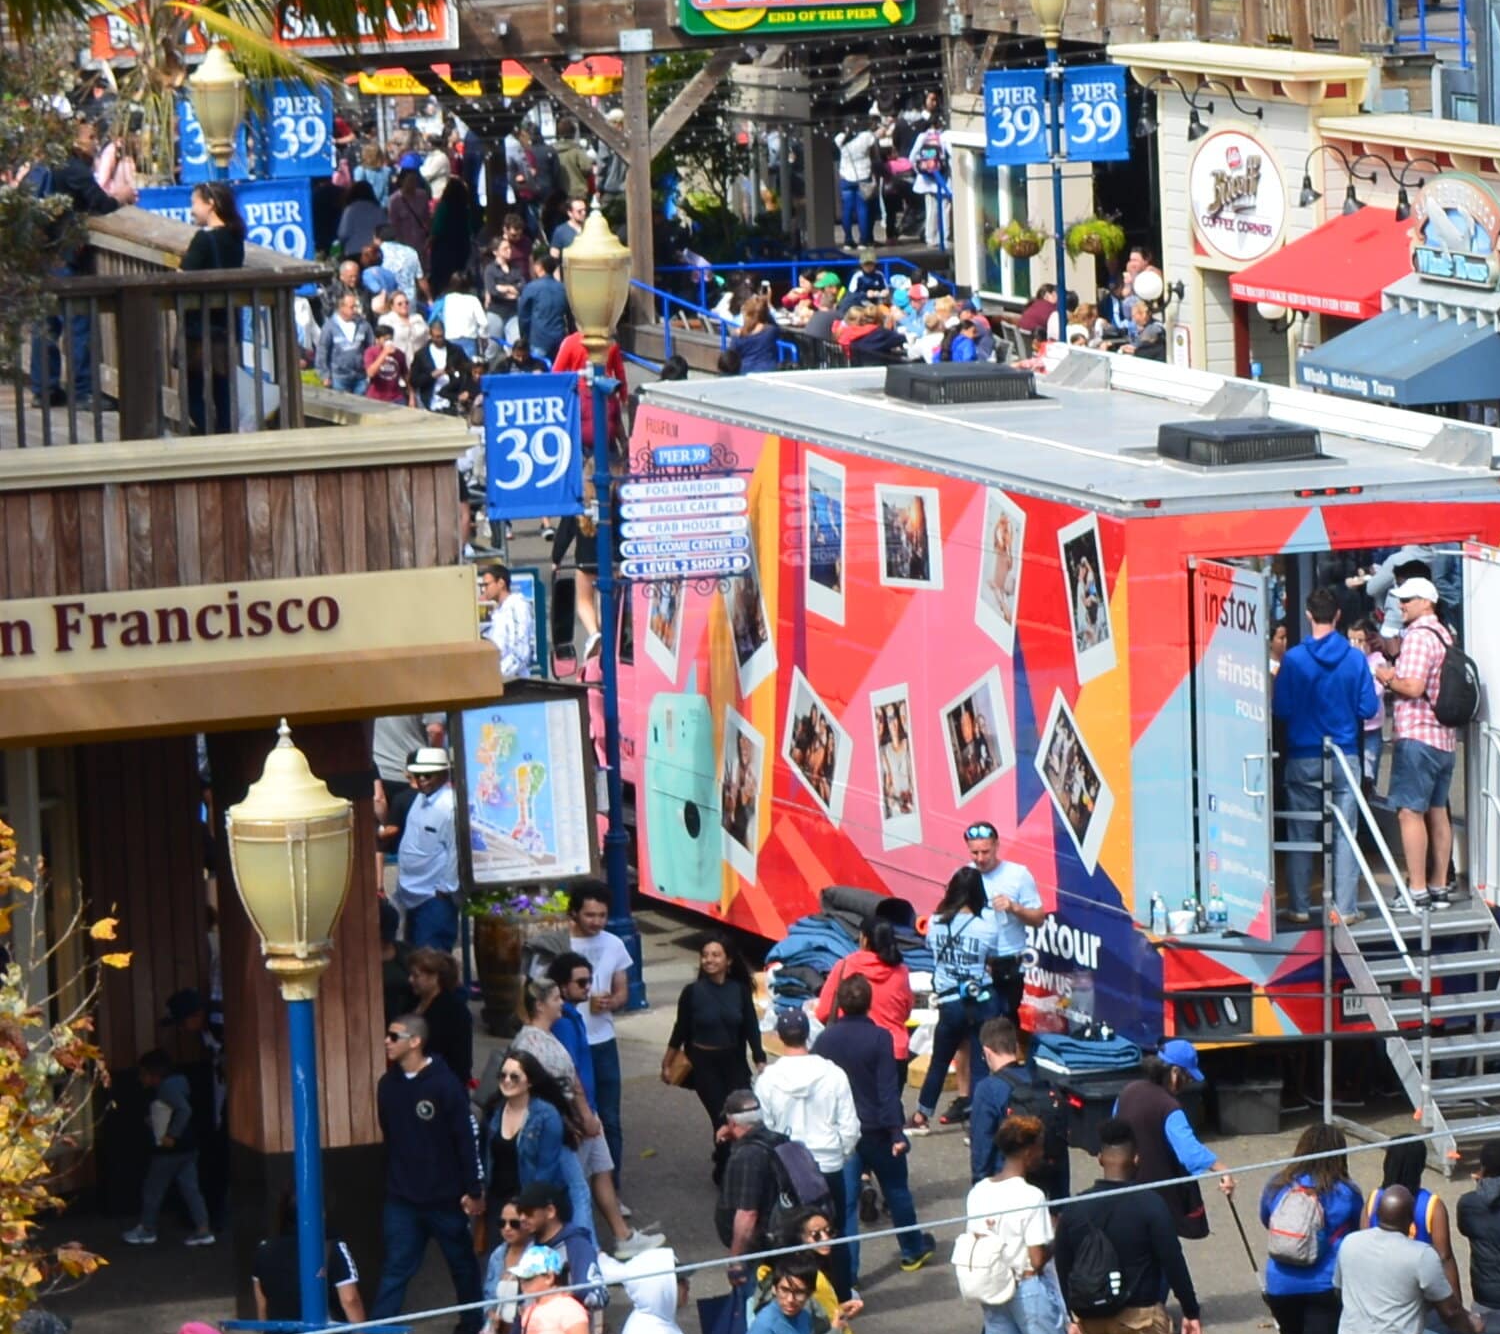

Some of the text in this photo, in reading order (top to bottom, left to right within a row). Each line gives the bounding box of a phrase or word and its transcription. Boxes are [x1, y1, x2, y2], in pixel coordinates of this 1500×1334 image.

[767, 6, 878, 24] END OF THE PIER
[992, 86, 1038, 105] PIER
[1071, 82, 1118, 102] PIER
[273, 95, 323, 116] PIER
[991, 105, 1041, 147] 39
[1071, 101, 1122, 143] 39
[272, 116, 328, 160] 39
[244, 200, 303, 225] PIER
[1202, 215, 1273, 237] COFFEE CORNER
[1303, 367, 1396, 398] Whale Watching Tours
[495, 396, 567, 427] PIER
[495, 425, 573, 490] 39
[659, 448, 708, 465] PIER 39
[646, 481, 721, 497] FOG HARBOR
[650, 499, 719, 515] EAGLE CAFE
[648, 519, 721, 534] CRAB HOUSE
[637, 537, 731, 554] WELCOME CENTER
[642, 557, 730, 573] LEVEL 2 SHOPS
[1203, 579, 1258, 635] instax
[52, 590, 341, 653] Francisco
[1056, 972, 1073, 998] US
